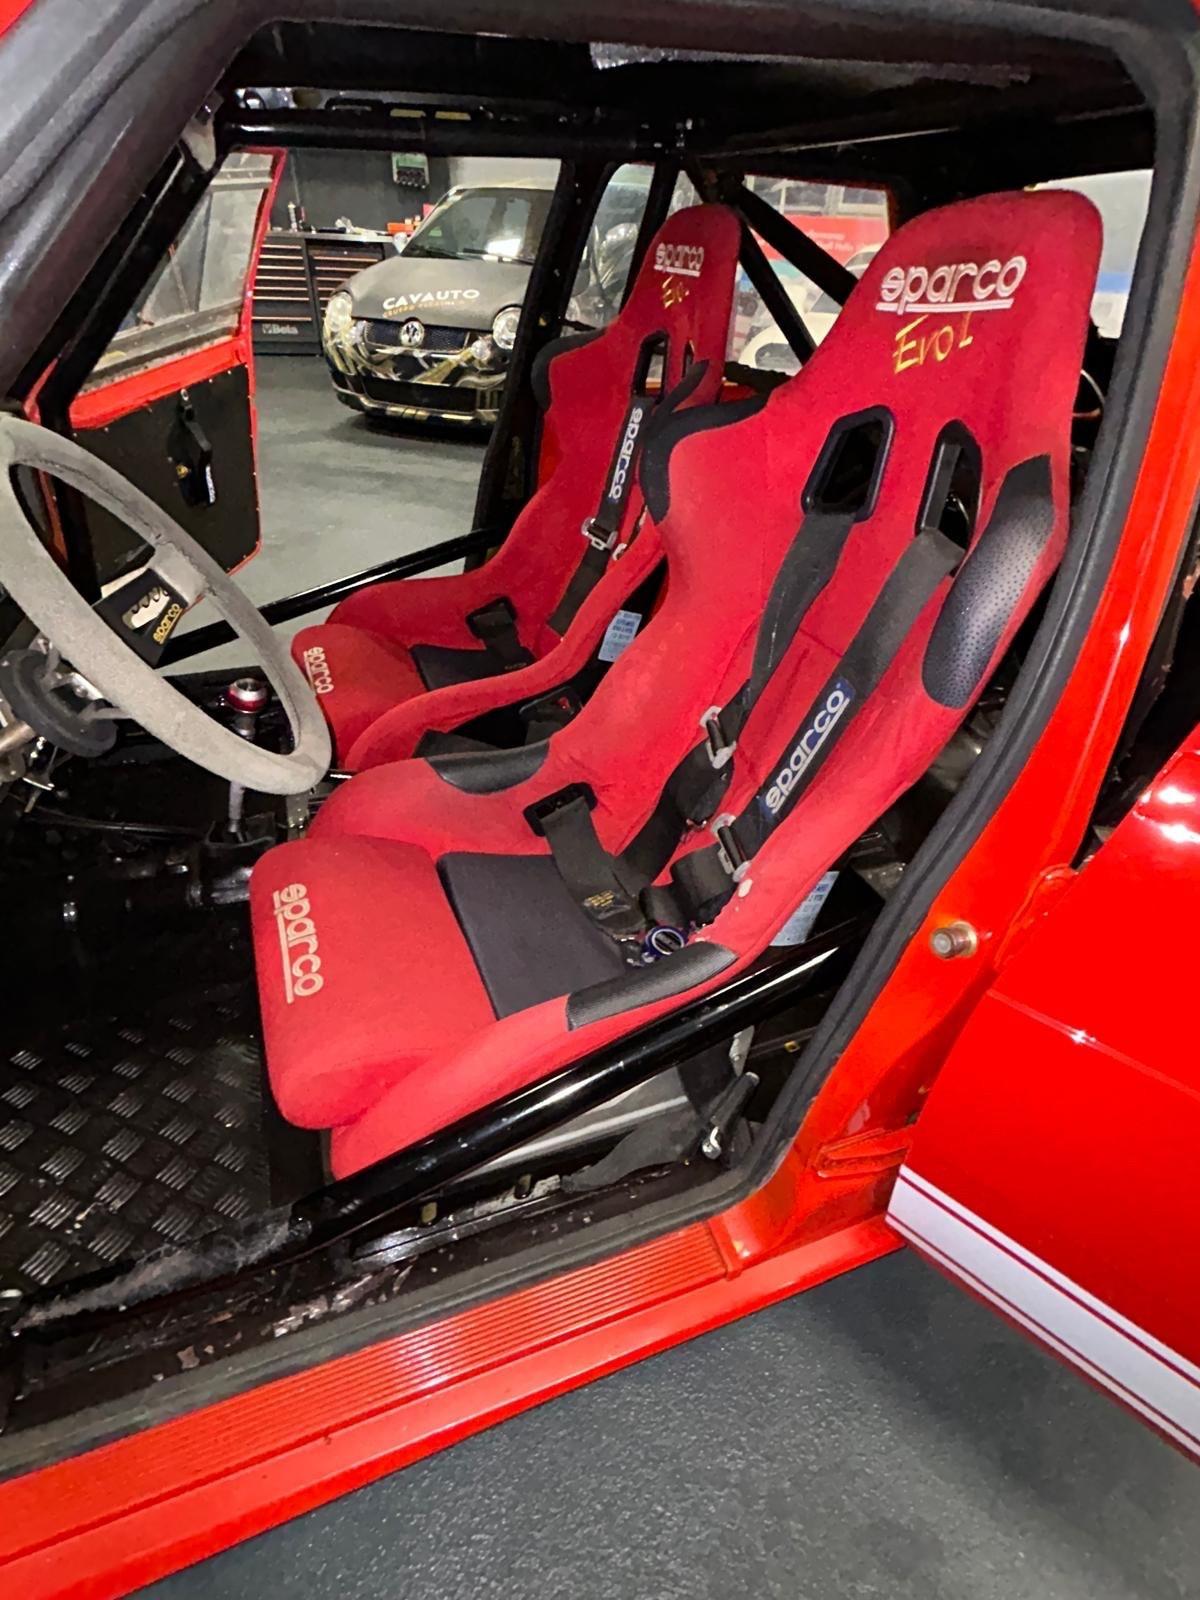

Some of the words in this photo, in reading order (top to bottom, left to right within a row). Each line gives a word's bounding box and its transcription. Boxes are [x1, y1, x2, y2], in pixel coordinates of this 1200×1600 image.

[655, 243, 705, 274] sparco
[880, 255, 1027, 315] sparco
[382, 289, 481, 311] CAVAUTO
[609, 407, 644, 500] sparco
[153, 603, 182, 643] sparco
[304, 646, 335, 694] sparco
[765, 689, 848, 813] sparco
[273, 883, 325, 1001] sparco
